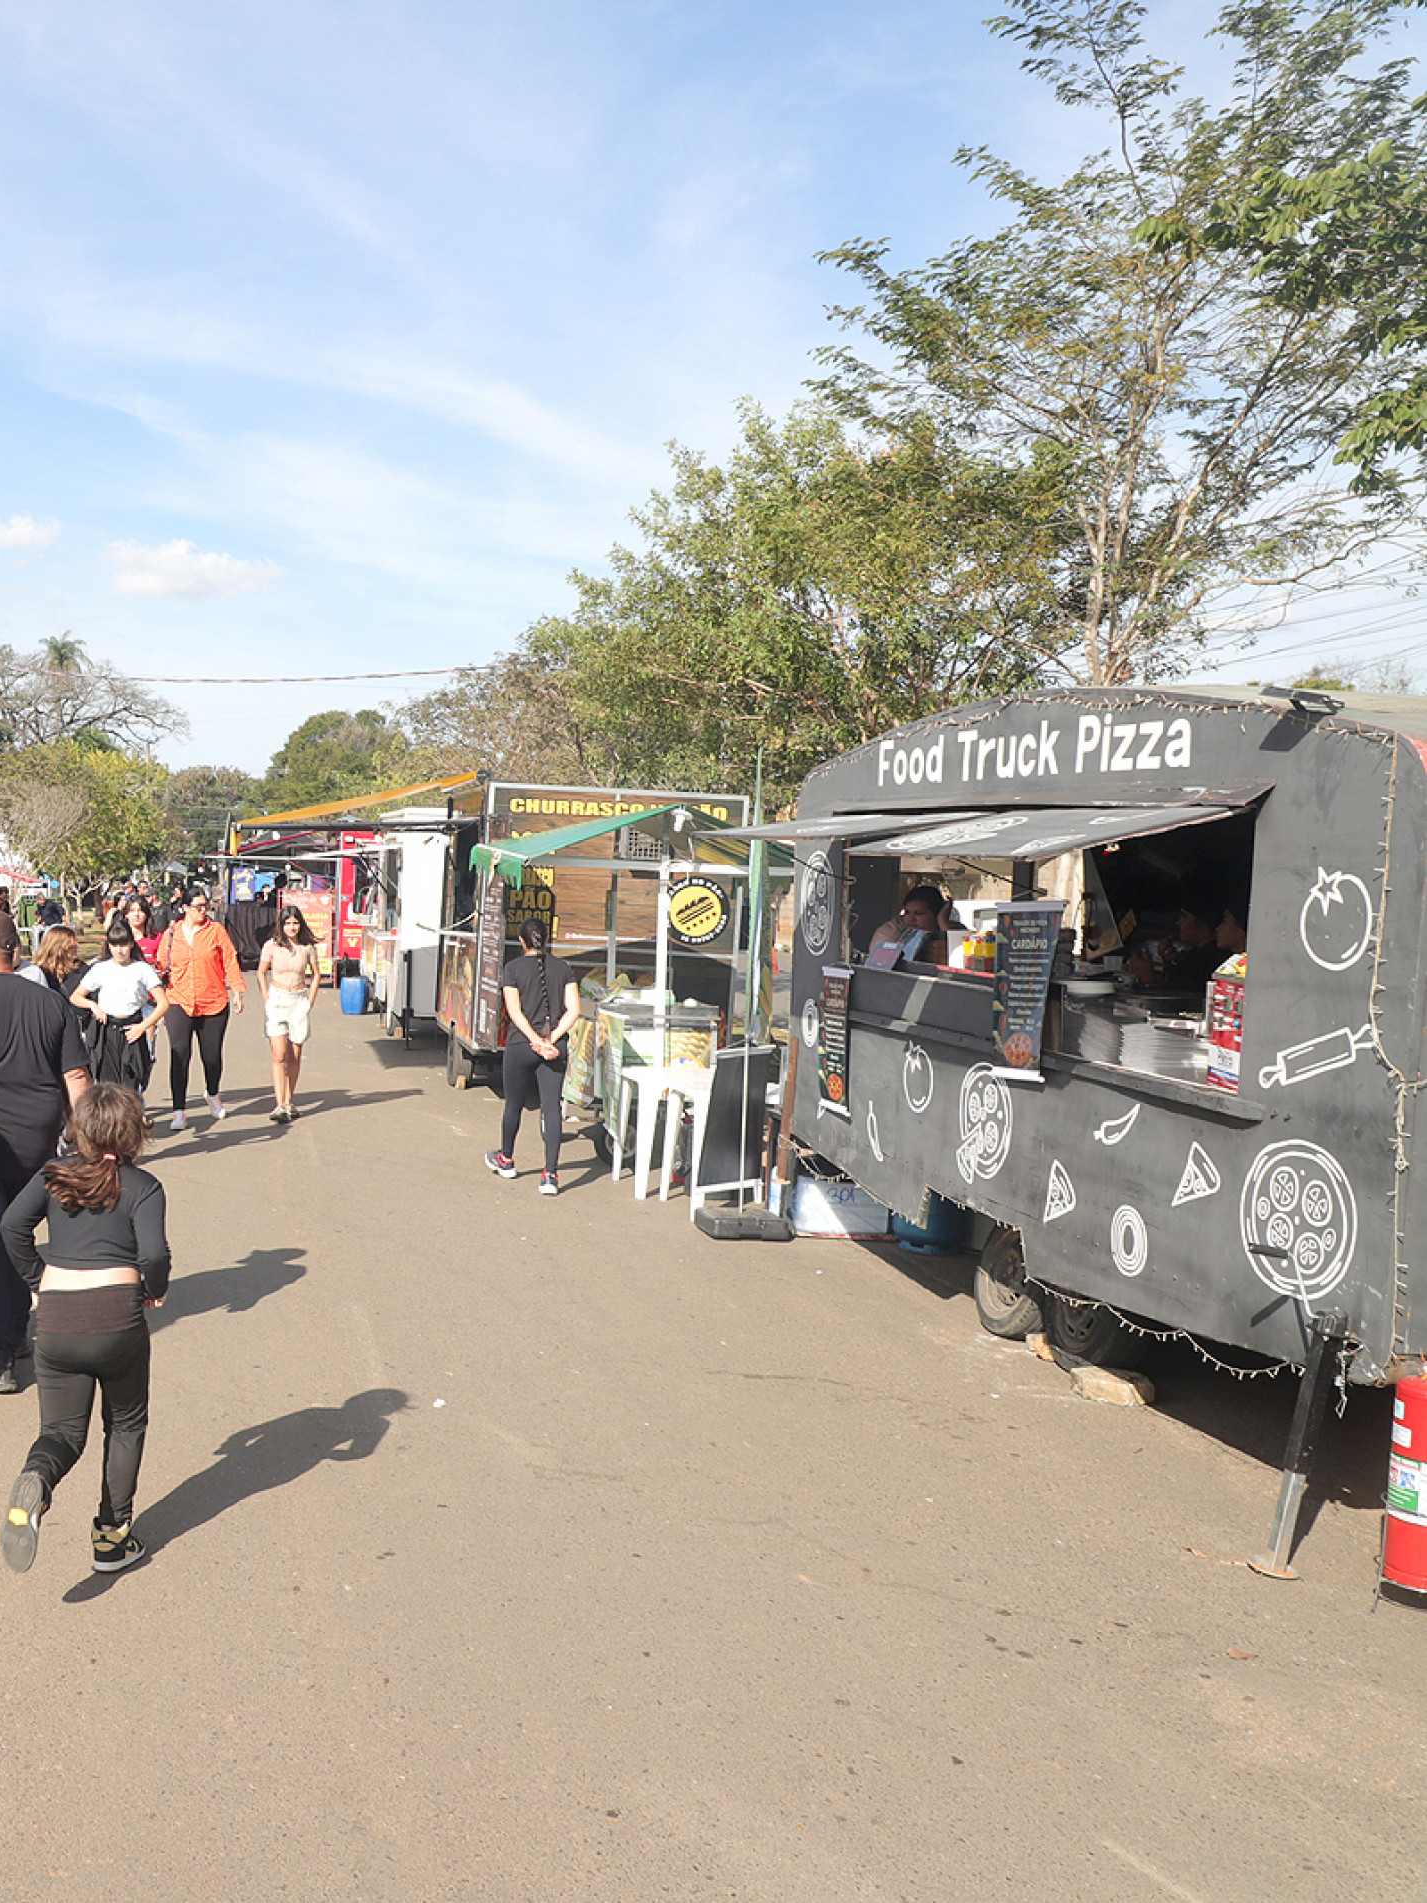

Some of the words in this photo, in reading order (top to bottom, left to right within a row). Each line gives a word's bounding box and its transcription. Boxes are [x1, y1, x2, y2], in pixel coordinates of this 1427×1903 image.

[877, 736, 945, 787] Food
[957, 719, 1061, 782] Truck
[1075, 712, 1192, 774] Pizza
[509, 798, 646, 815] CHURRASCO
[509, 886, 552, 911] PÃO
